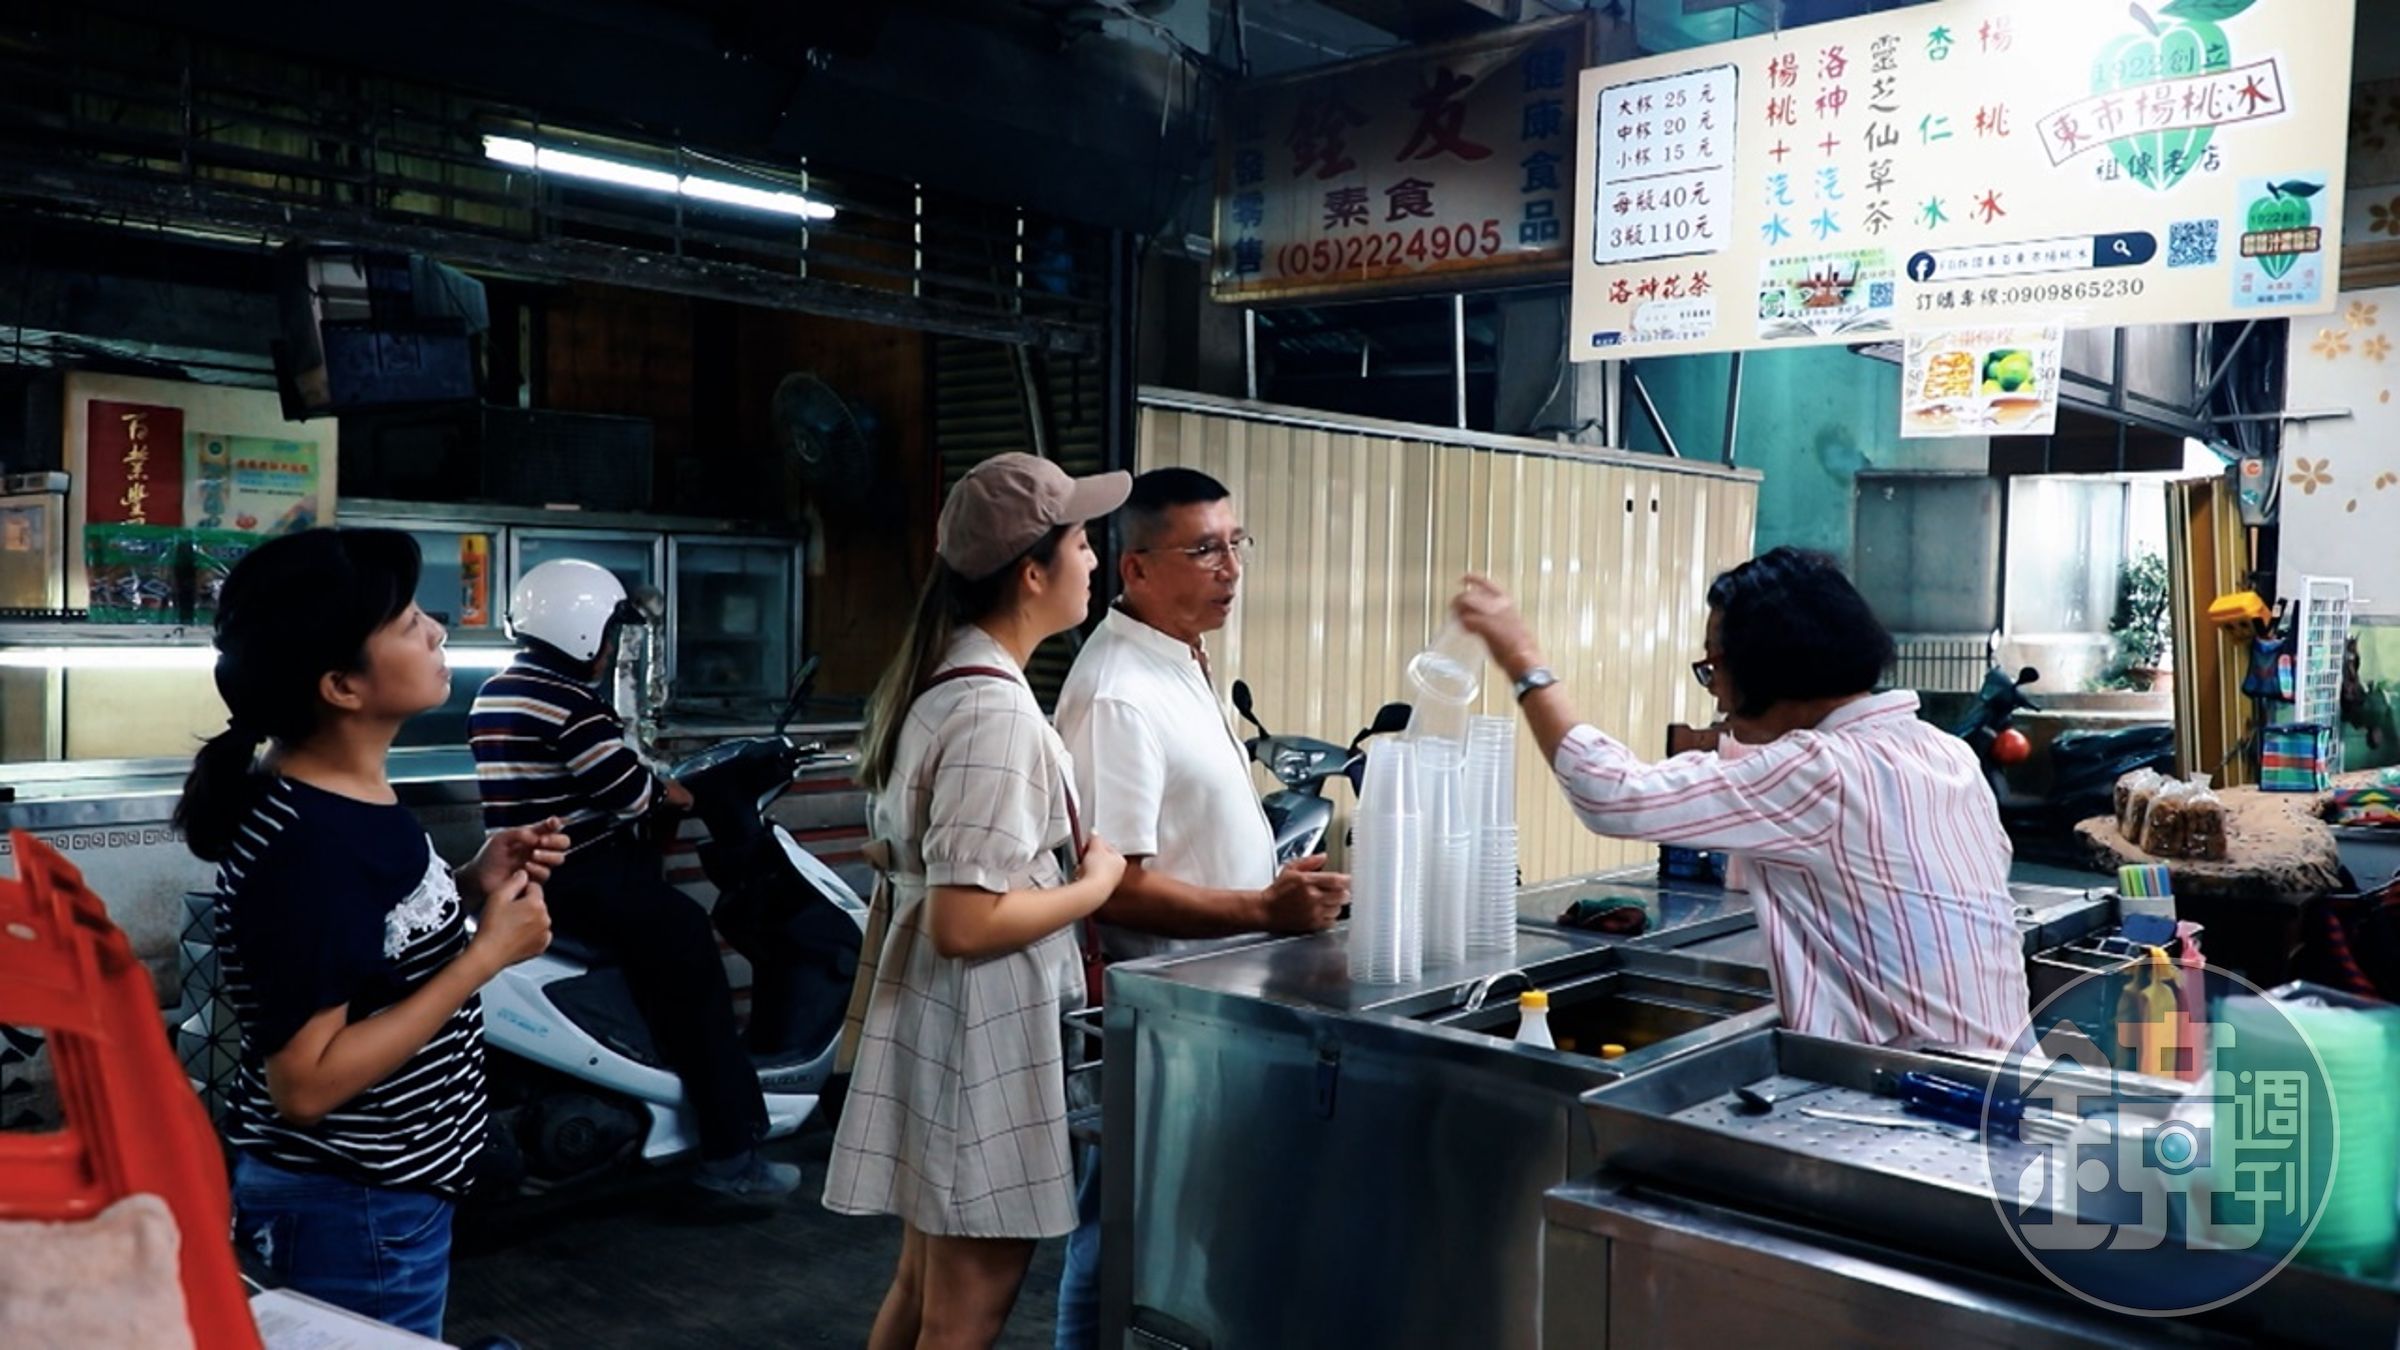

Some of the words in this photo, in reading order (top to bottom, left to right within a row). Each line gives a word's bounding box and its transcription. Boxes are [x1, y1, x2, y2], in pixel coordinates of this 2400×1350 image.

[1663, 116, 1687, 136] 20
[1664, 88, 1688, 109] 25
[1969, 15, 2012, 224] 楊桃冰
[2052, 74, 2274, 152] 東市楊桃冰
[1518, 47, 1567, 246] 健康食品
[1663, 143, 1686, 162] 15
[1914, 26, 1954, 230] 杏仁冰
[1323, 177, 1436, 231] 素食
[1277, 219, 1502, 277] (05)2224905
[1608, 270, 1713, 305] 洛神花茶
